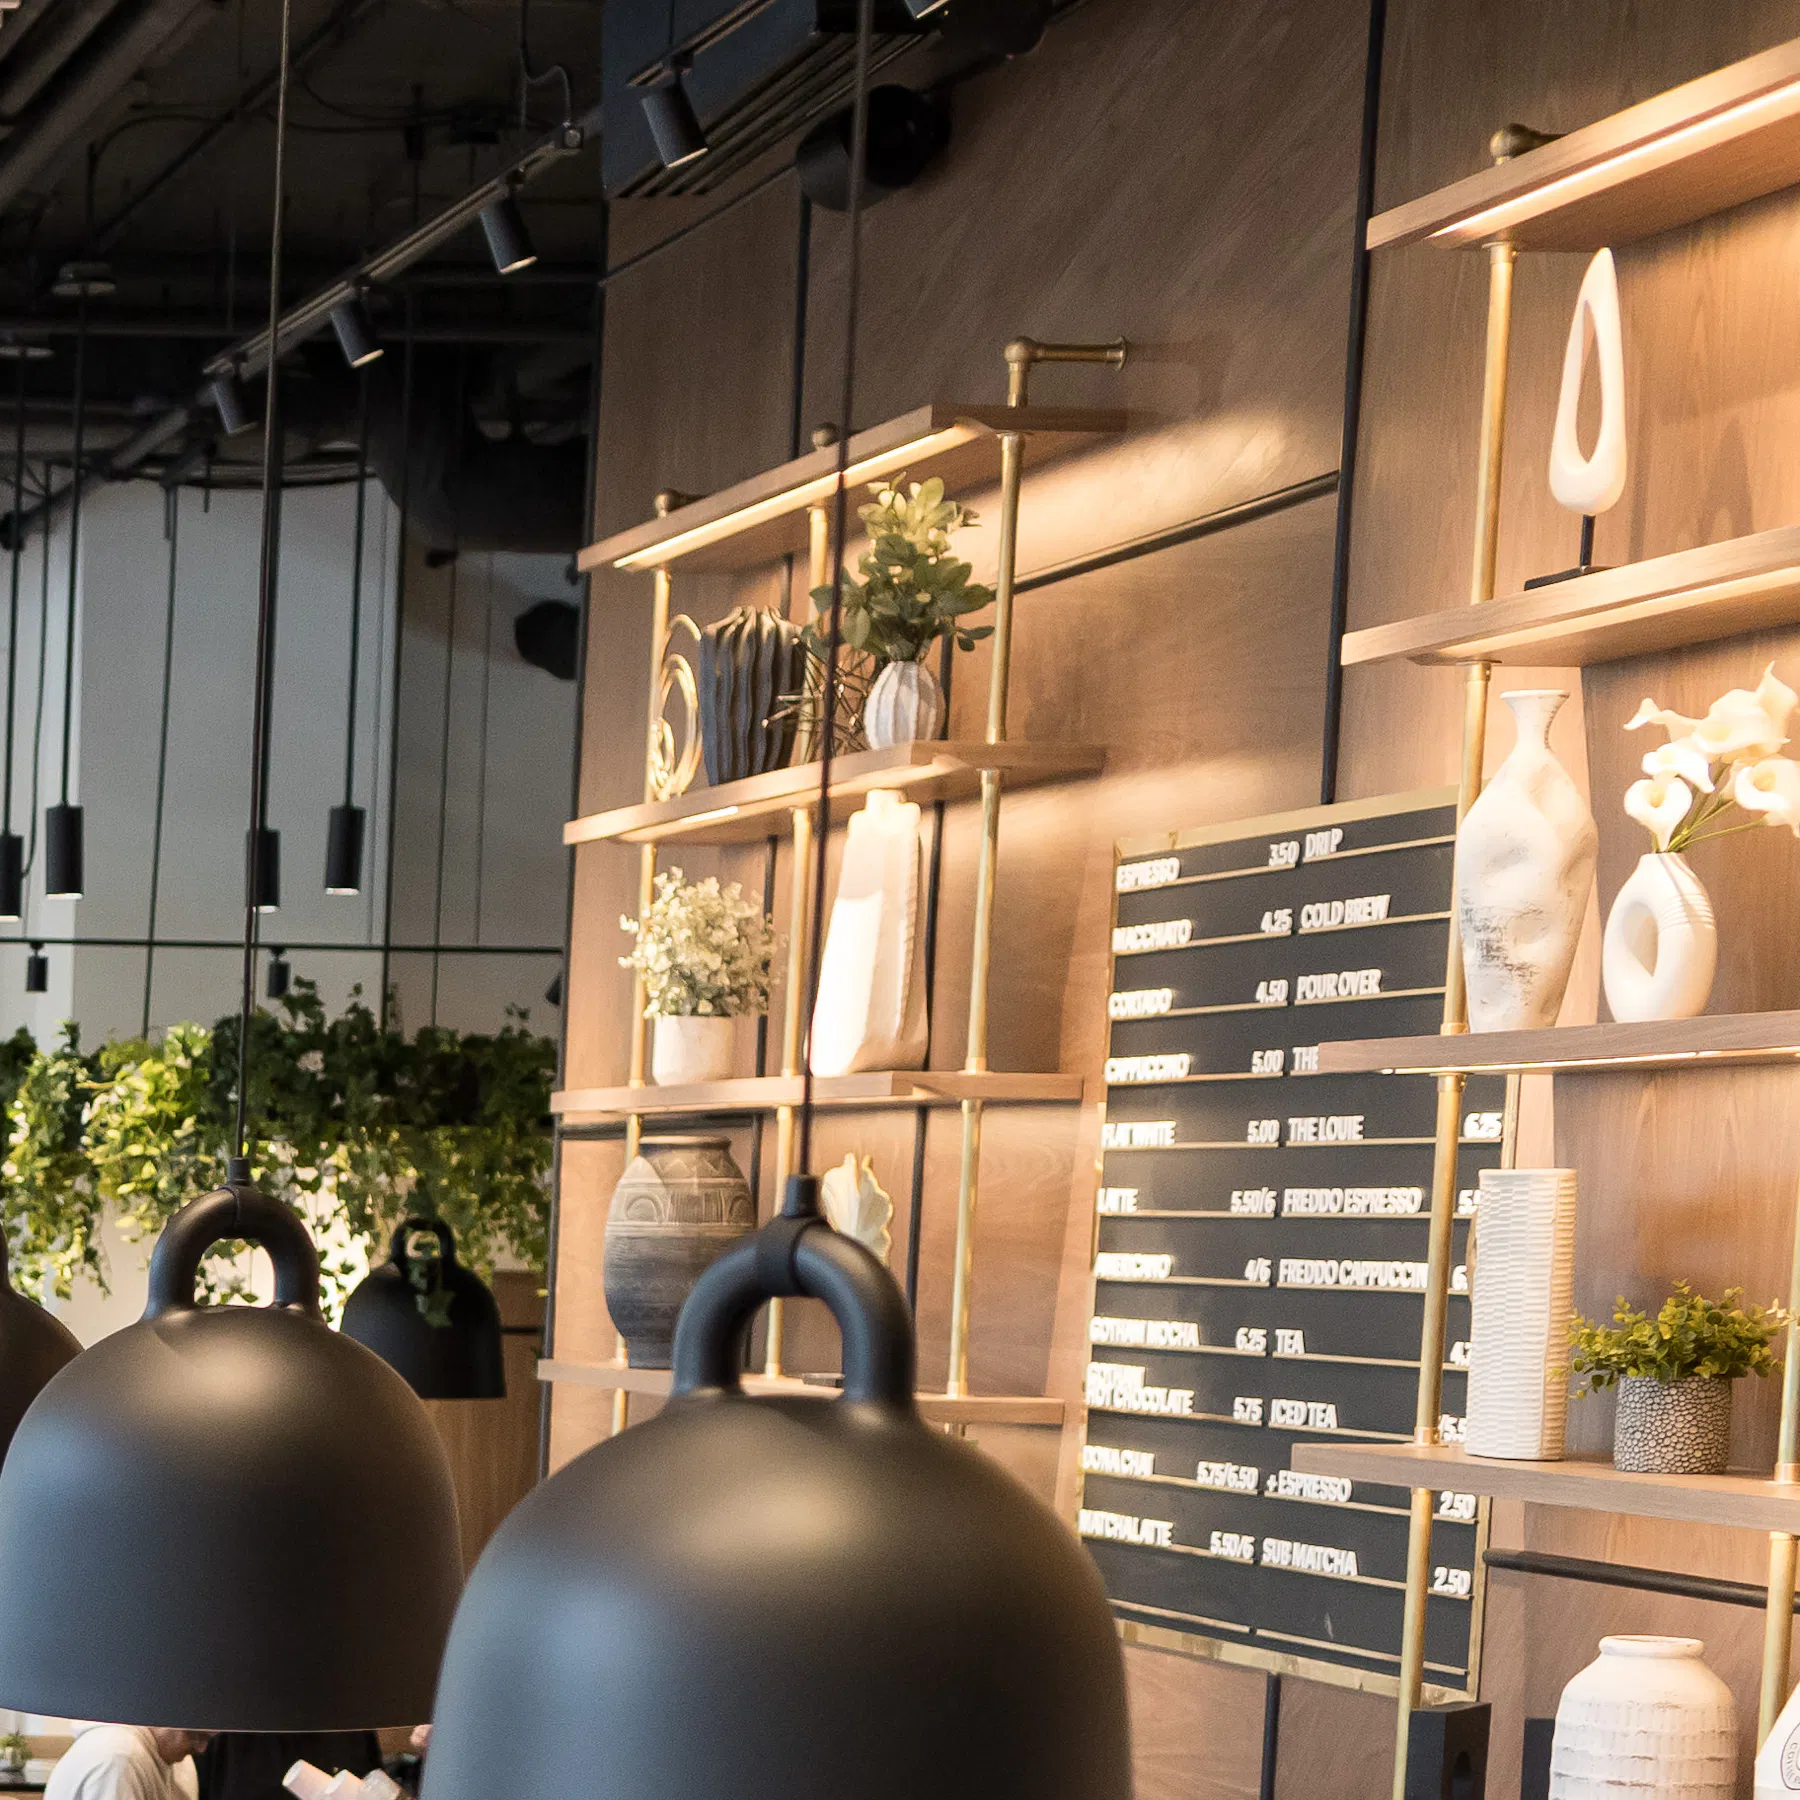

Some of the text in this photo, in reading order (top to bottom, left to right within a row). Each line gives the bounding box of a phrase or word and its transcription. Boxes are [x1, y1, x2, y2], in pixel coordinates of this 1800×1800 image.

[1116, 840, 1299, 889] ESPRESSO 3.50
[1260, 908, 1293, 933] 4.25
[1300, 895, 1391, 929] COLD BREW
[1109, 979, 1288, 1016] CORTADO 4.50
[1297, 969, 1382, 1000] POUR OVER
[1252, 1050, 1284, 1074] 5.00
[1101, 1119, 1280, 1146] FLAT WHITE 5.00
[1288, 1117, 1318, 1142] THE
[1463, 1112, 1502, 1139] 6.25
[1096, 1187, 1277, 1213] LATTE 5.50/6
[1283, 1188, 1344, 1213] FREDDO
[1344, 1186, 1423, 1213] ESPRESSO
[1245, 1257, 1272, 1284] 4/6
[1279, 1258, 1339, 1285] FREDDO
[1089, 1316, 1267, 1353] GOTHAM MOCHA 6.25
[1275, 1329, 1305, 1354] TEA
[1233, 1396, 1262, 1421] 5.75
[1269, 1398, 1307, 1426] ICED
[1307, 1401, 1337, 1429] TEA
[1196, 1461, 1259, 1491] 5.75/6.50
[1278, 1469, 1352, 1502] ESPRESSO
[1440, 1492, 1476, 1519] 2.50
[1210, 1531, 1255, 1560] 5.50/6
[1262, 1537, 1471, 1595] SUB MATCHA 2.50
